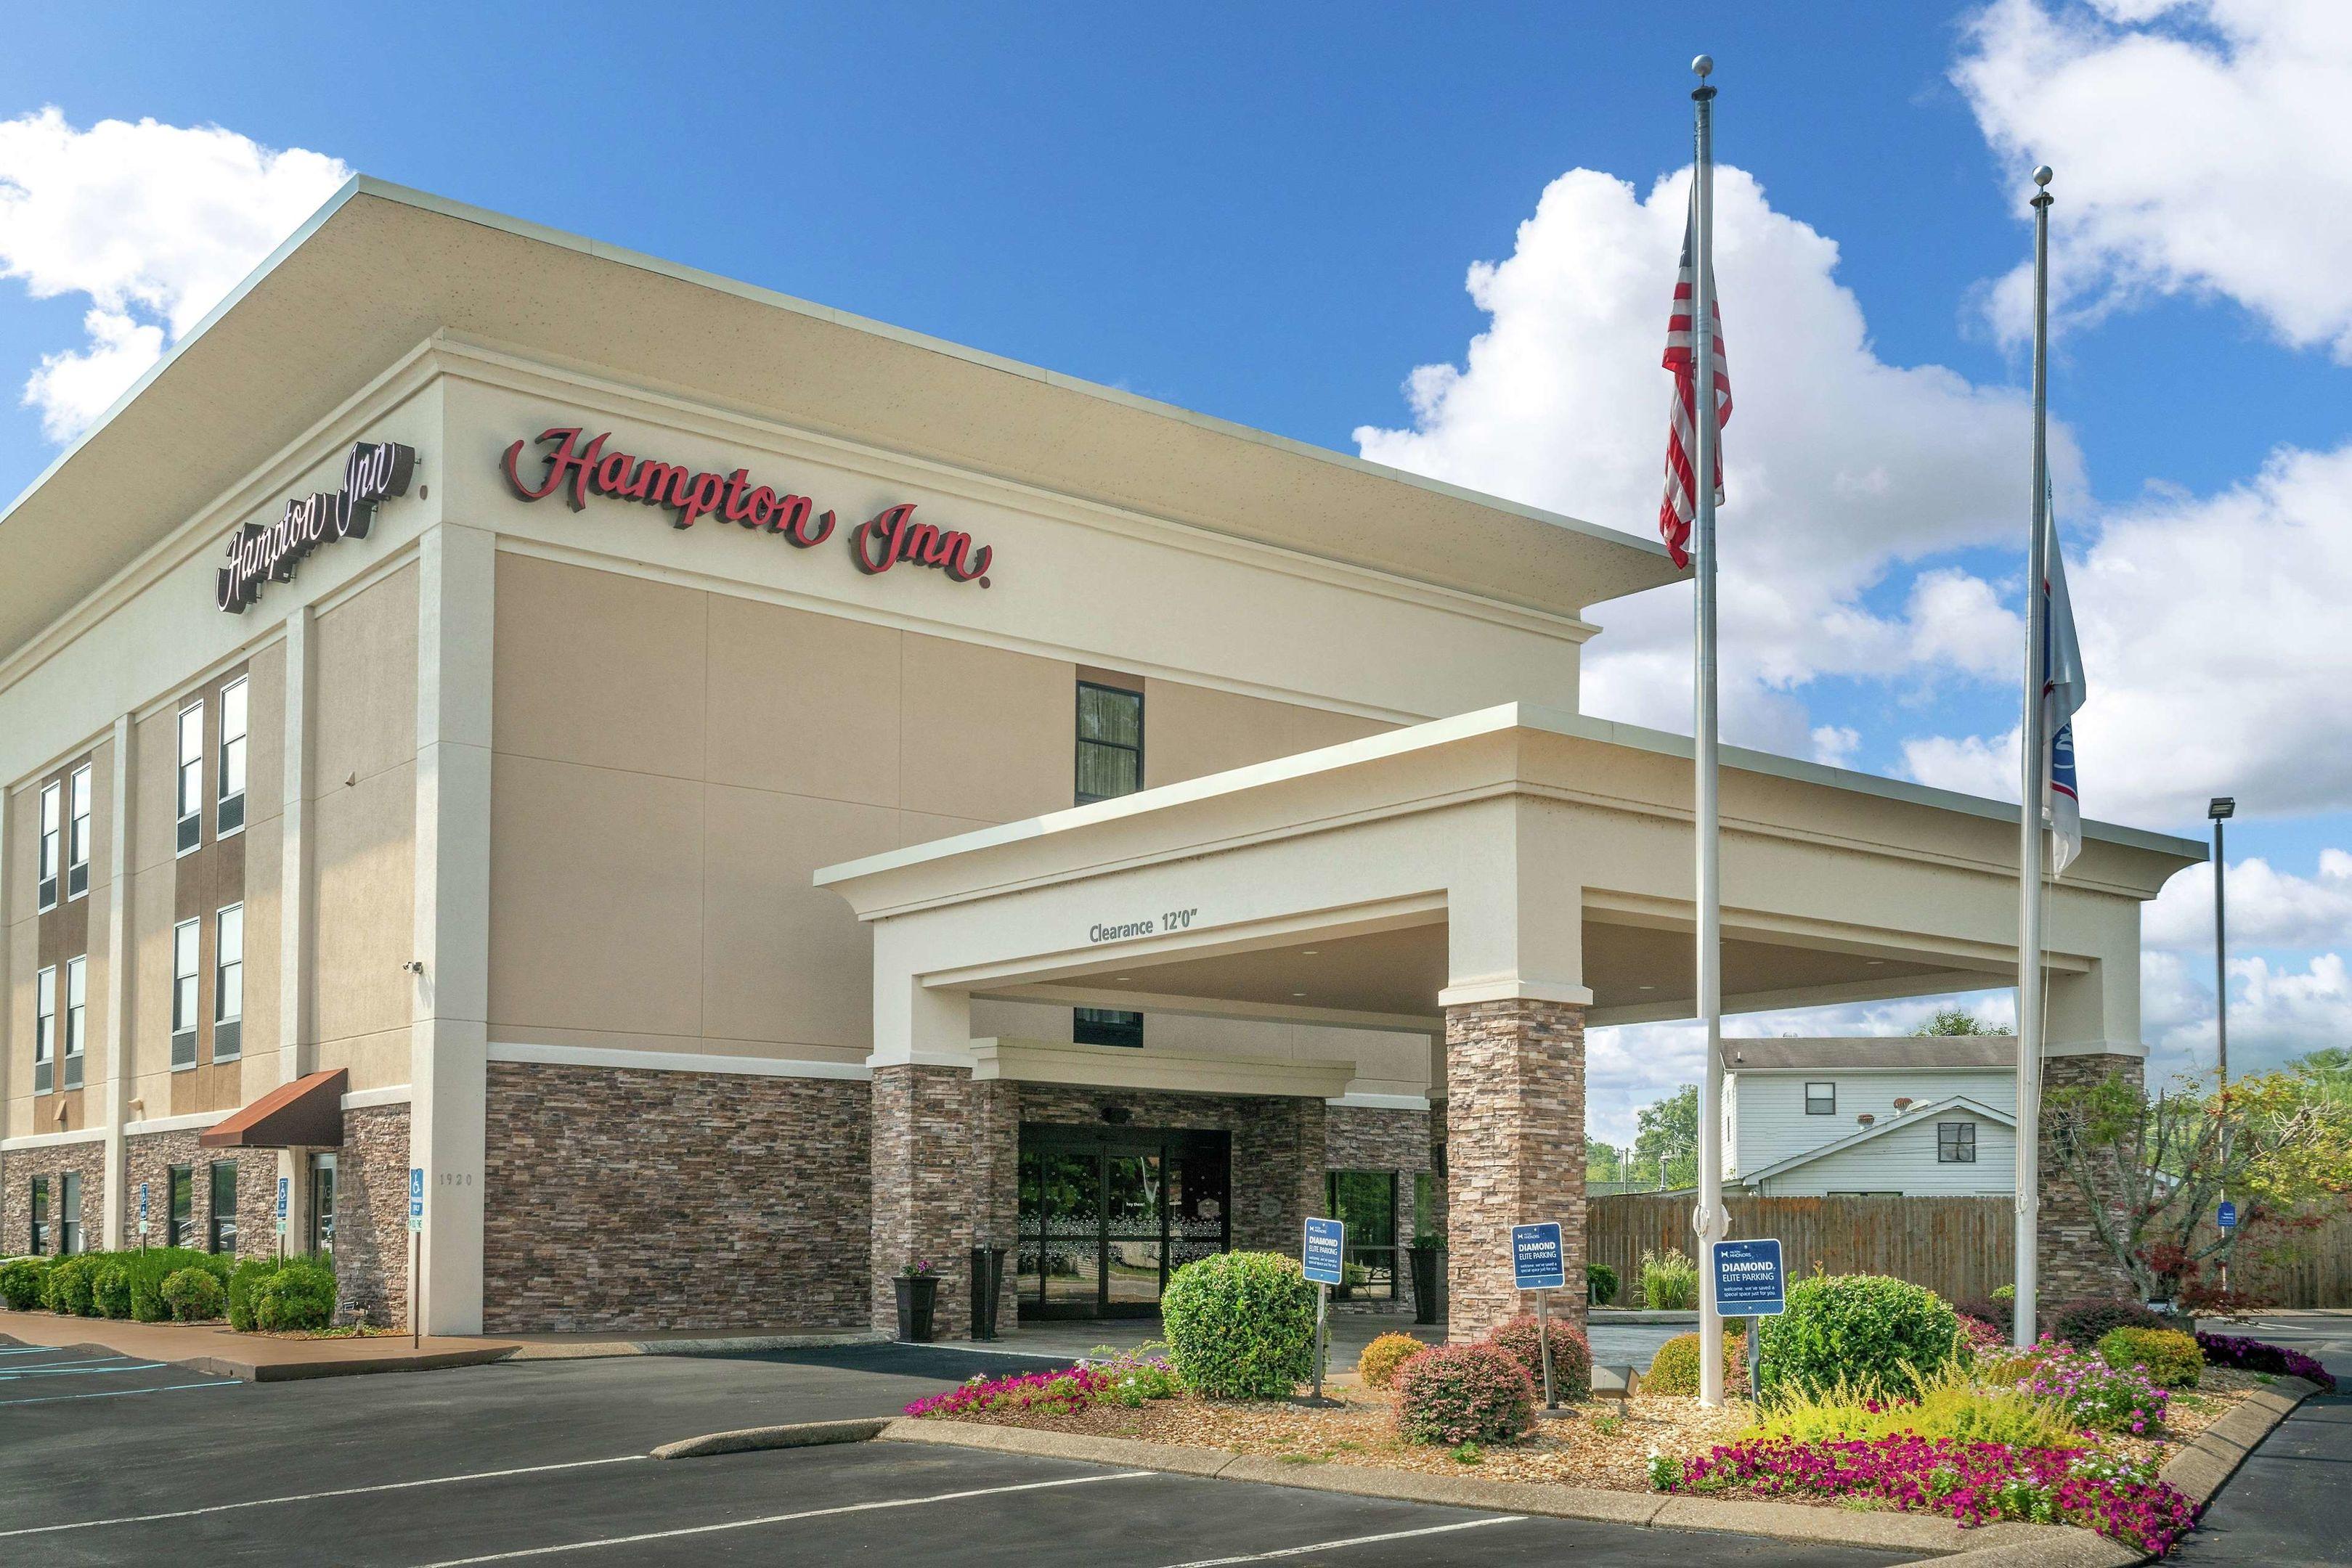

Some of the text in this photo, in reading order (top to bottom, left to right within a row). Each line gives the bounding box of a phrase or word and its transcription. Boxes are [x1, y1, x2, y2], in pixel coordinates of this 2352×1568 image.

[501, 428, 836, 550] Hampton
[216, 441, 407, 612] Hampton Inn
[1089, 919, 1153, 943] Clearance
[440, 1173, 472, 1186] 1920
[1309, 1236, 1338, 1247] DIAMOND
[1518, 1241, 1556, 1251] DIAMOND
[1533, 1251, 1557, 1259] PARKING
[1722, 1262, 1773, 1273] DIAMOND
[1723, 1273, 1774, 1283] ELITE PARKING
